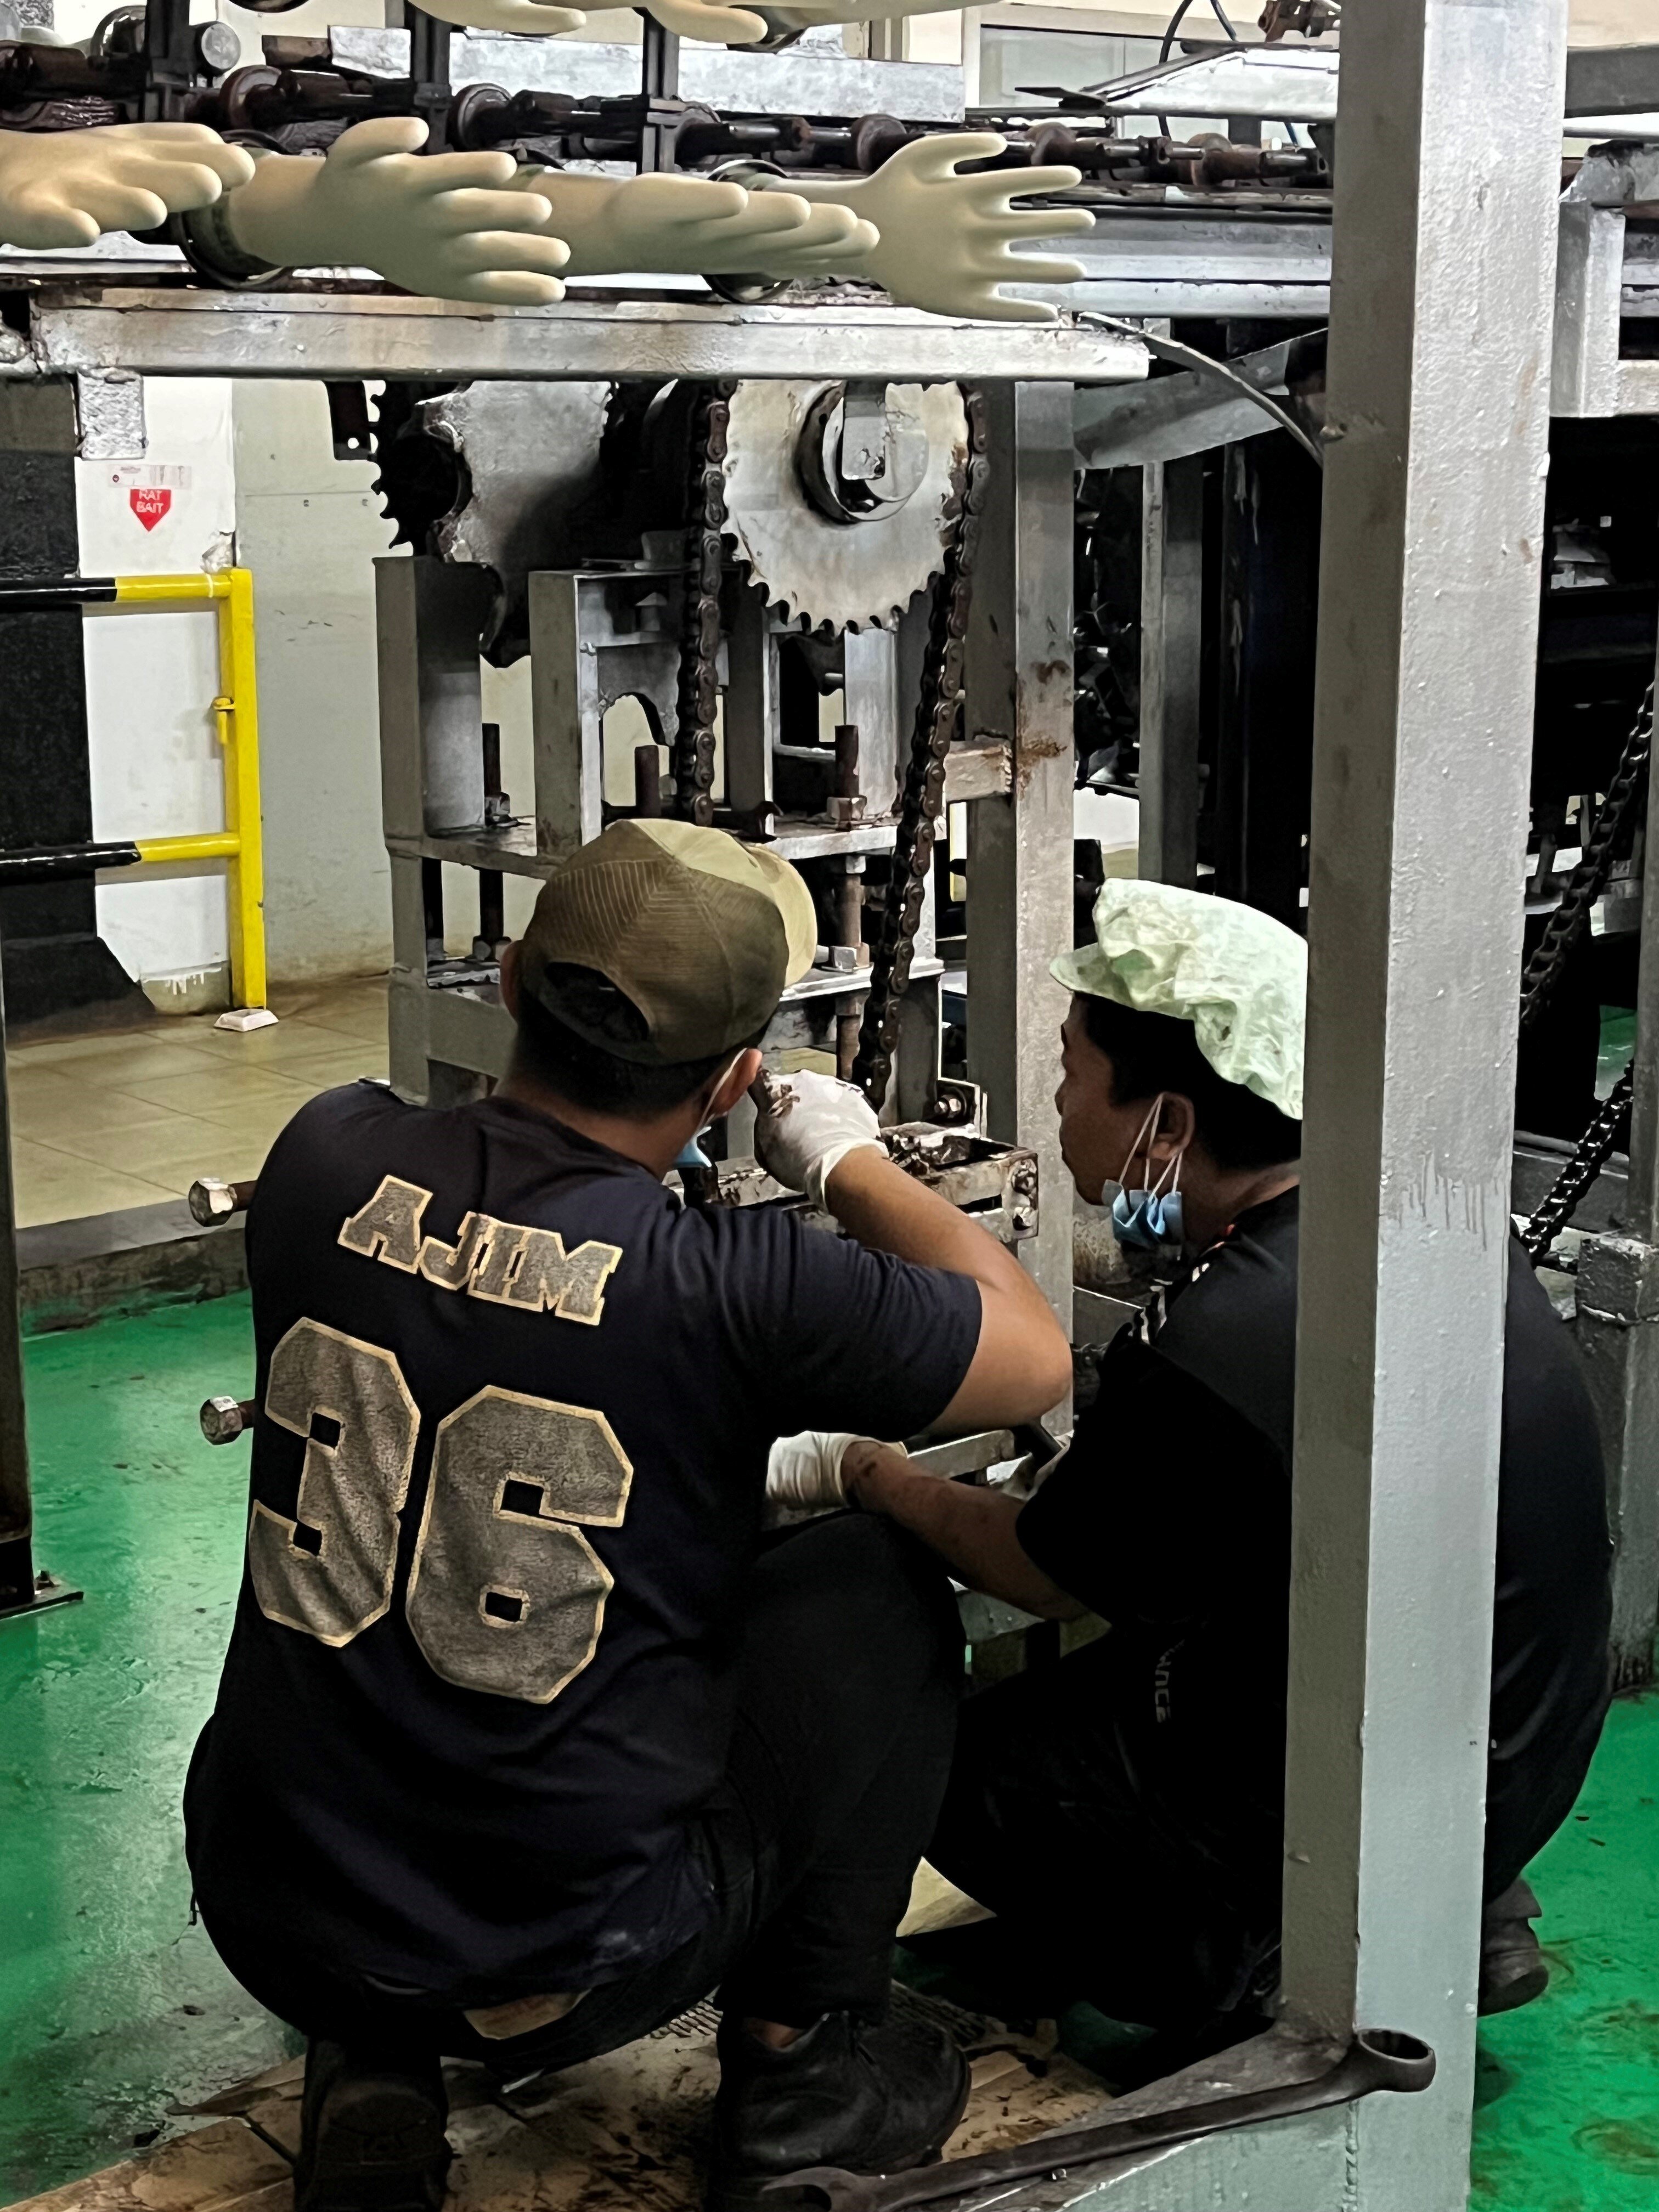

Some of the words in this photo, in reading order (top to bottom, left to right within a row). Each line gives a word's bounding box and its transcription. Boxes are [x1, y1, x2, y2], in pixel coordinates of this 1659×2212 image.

[137, 501, 163, 514] BAIT
[139, 489, 162, 500] RAT
[337, 1175, 623, 1325] AJIM
[249, 1317, 633, 1703] 36
